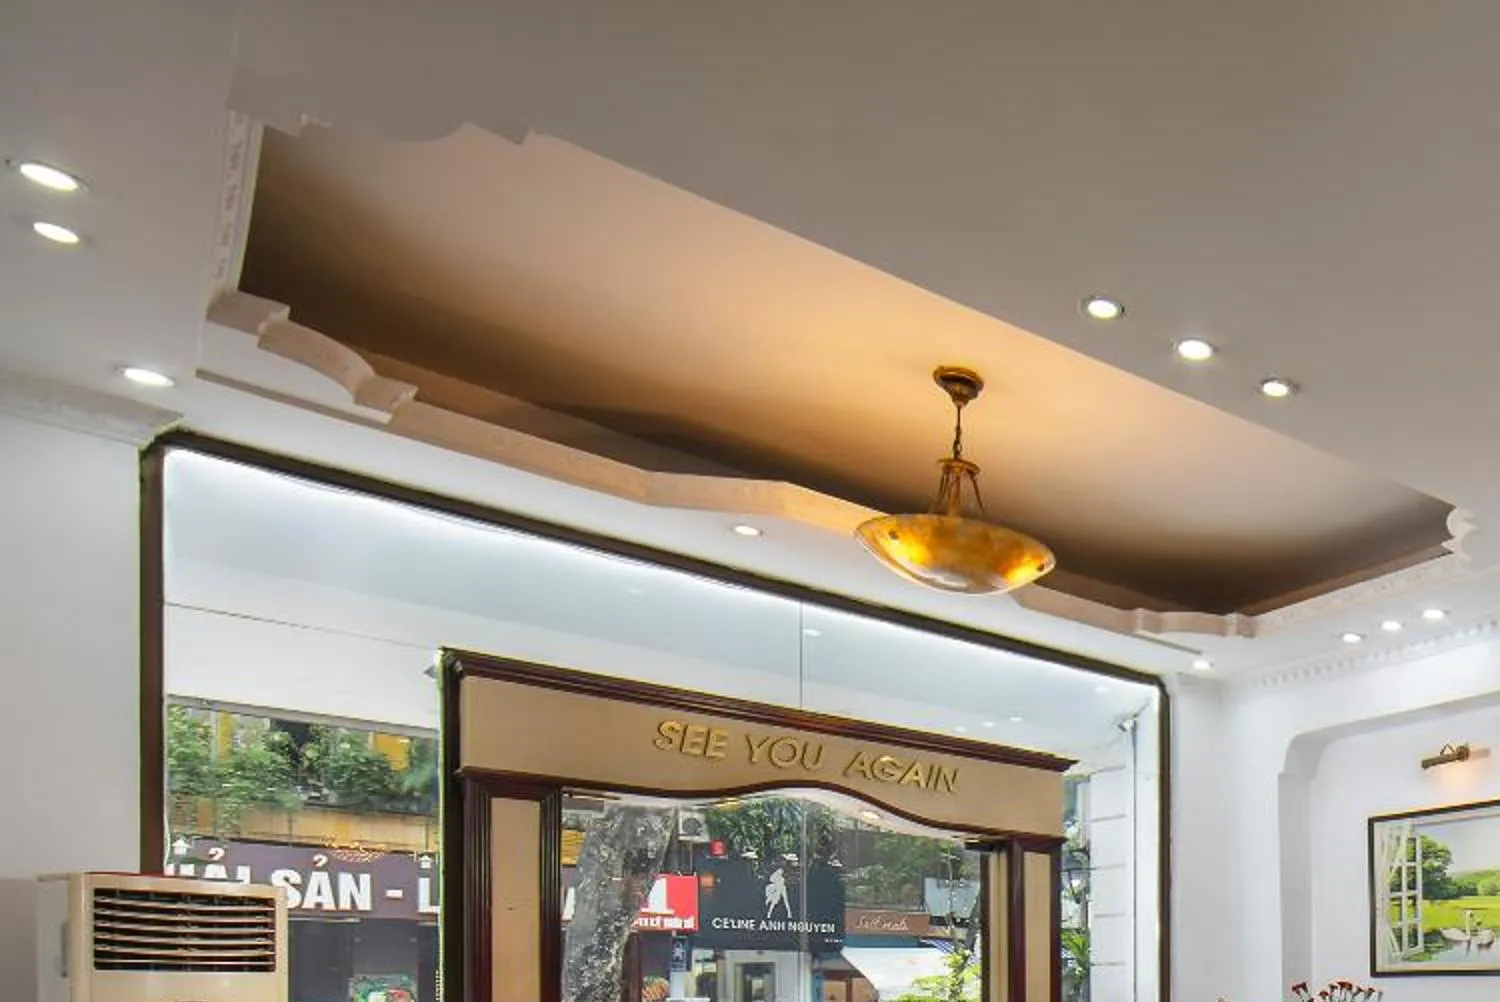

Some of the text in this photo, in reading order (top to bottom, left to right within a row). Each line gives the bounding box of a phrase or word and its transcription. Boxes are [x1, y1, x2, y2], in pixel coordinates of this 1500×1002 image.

[653, 720, 959, 793] SEE YOU AGAIN
[271, 854, 372, 911] SẢN
